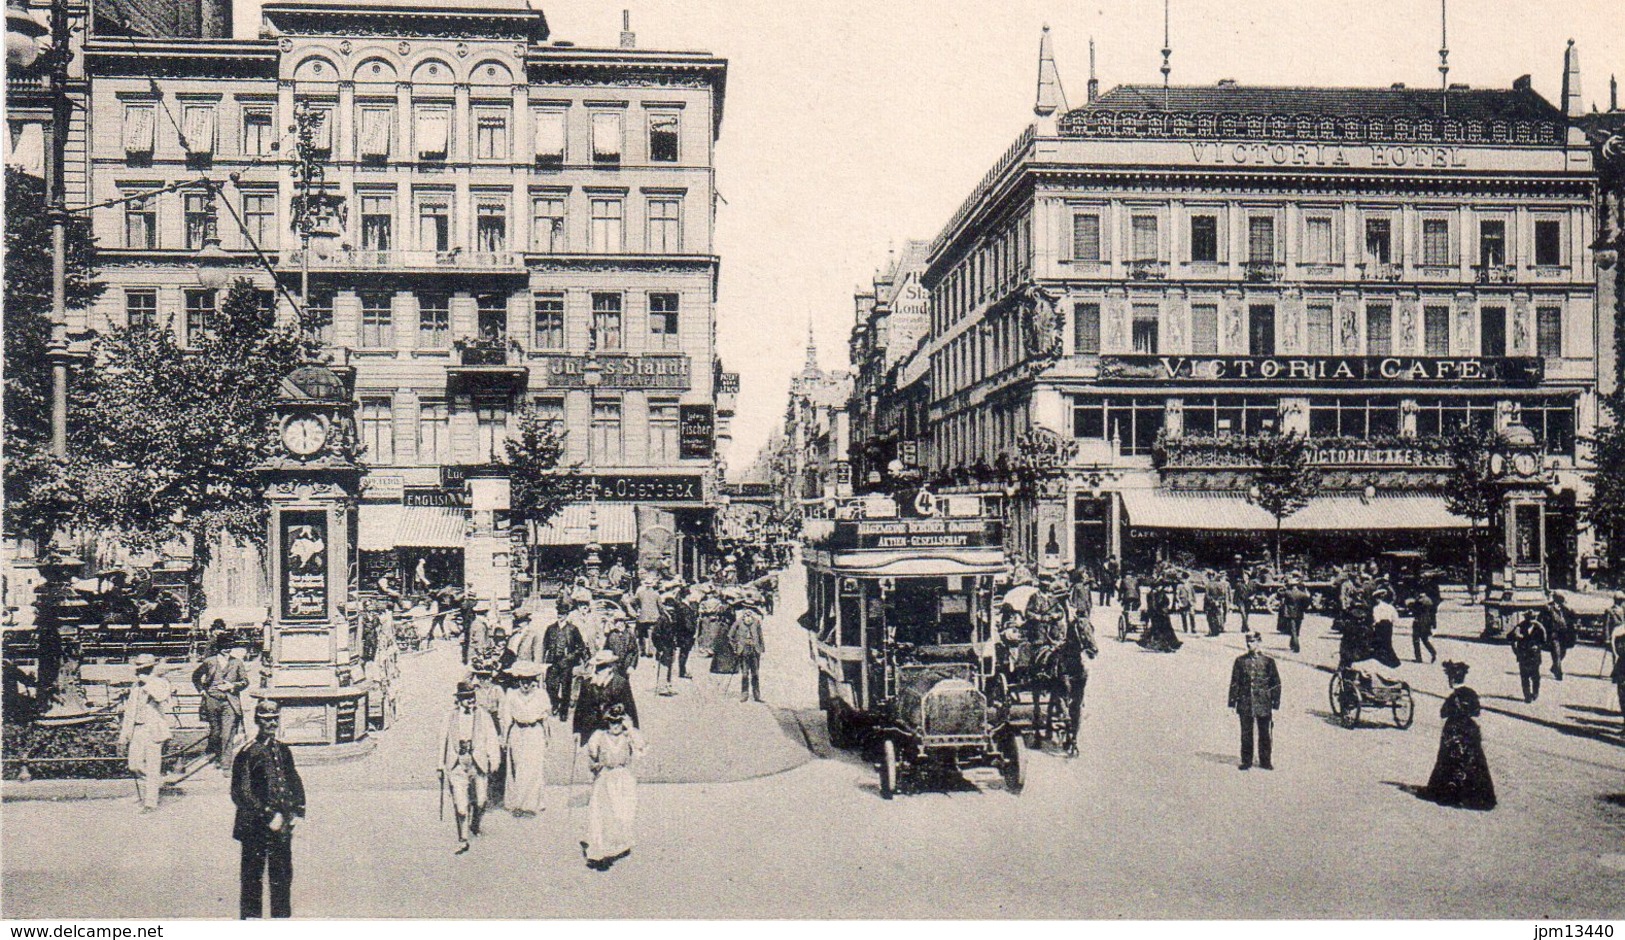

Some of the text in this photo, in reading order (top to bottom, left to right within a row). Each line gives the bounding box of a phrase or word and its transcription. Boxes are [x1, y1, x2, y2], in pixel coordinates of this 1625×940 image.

[1189, 142, 1467, 168] VICTORIA HOTEL
[622, 357, 689, 376] Staudt
[1159, 357, 1355, 378] VICTORIA
[681, 421, 712, 435] Fischer
[1304, 450, 1371, 464] VICTORIA
[447, 468, 464, 479] Luc
[616, 478, 694, 498] Oberbeck
[918, 493, 932, 512] 4
